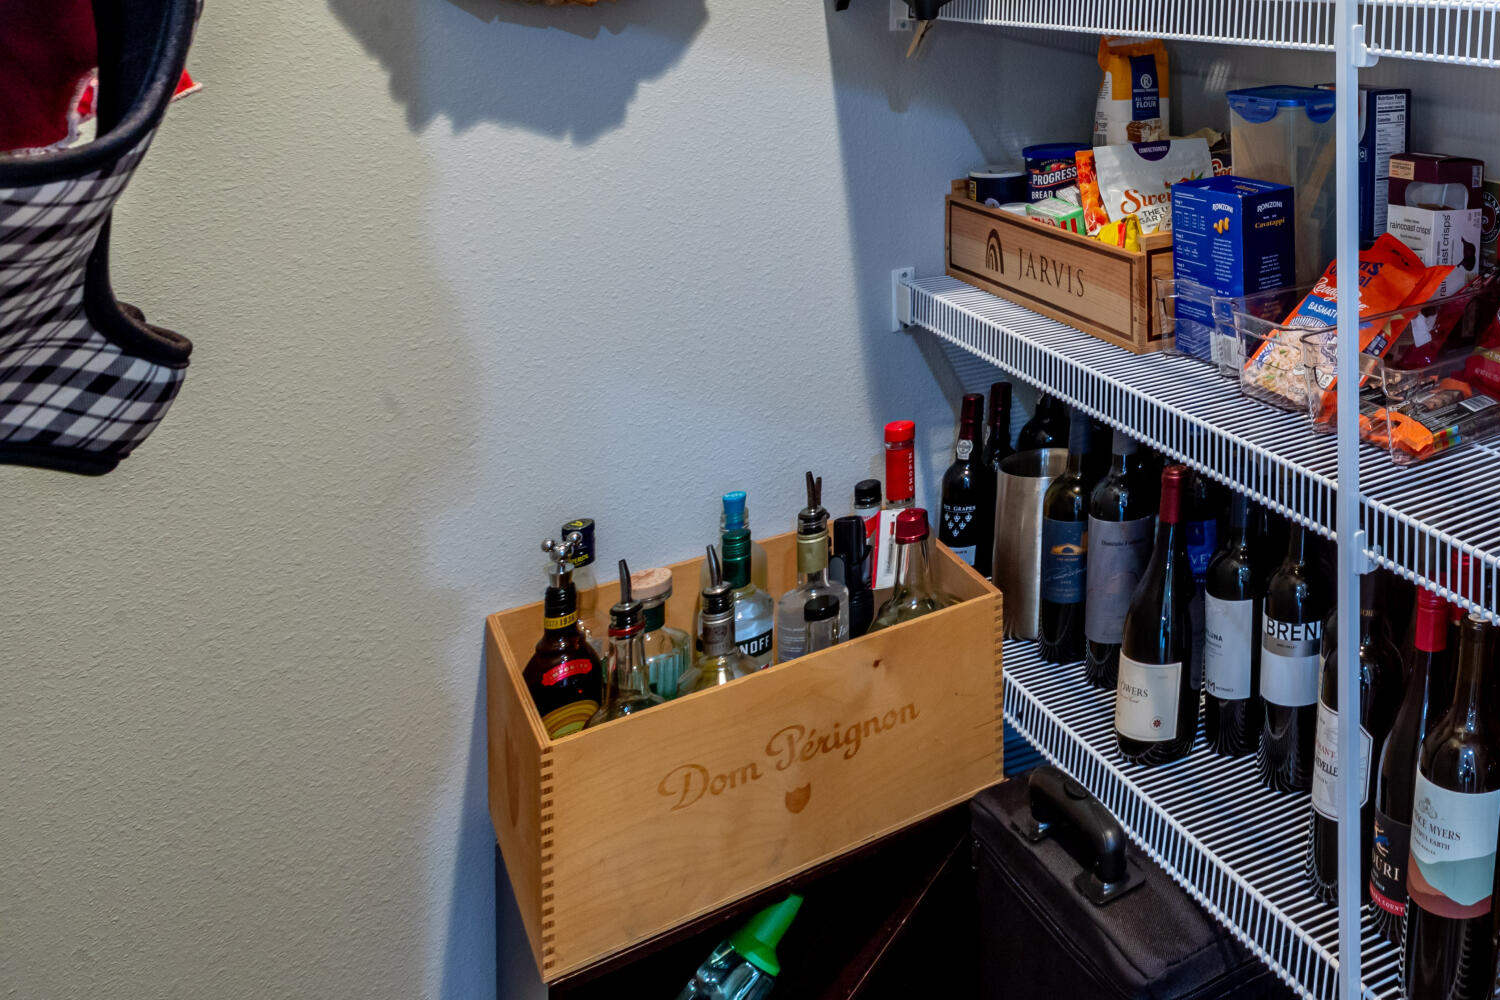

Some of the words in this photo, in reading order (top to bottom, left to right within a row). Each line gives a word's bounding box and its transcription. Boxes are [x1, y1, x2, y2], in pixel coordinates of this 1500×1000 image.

[1135, 100, 1157, 109] FLOUR
[1031, 190, 1054, 201] BREAD
[1212, 202, 1235, 214] RONZONI
[1257, 200, 1284, 213] RONZONI
[1142, 208, 1161, 219] THE
[1254, 216, 1286, 229] Cavatappi
[1389, 220, 1416, 233] raincoast
[1018, 248, 1086, 298] JARVIS
[953, 504, 977, 513] GRAPES
[656, 759, 763, 815] Dom
[765, 702, 922, 774] Pérignon
[1429, 823, 1462, 842] MYERS
